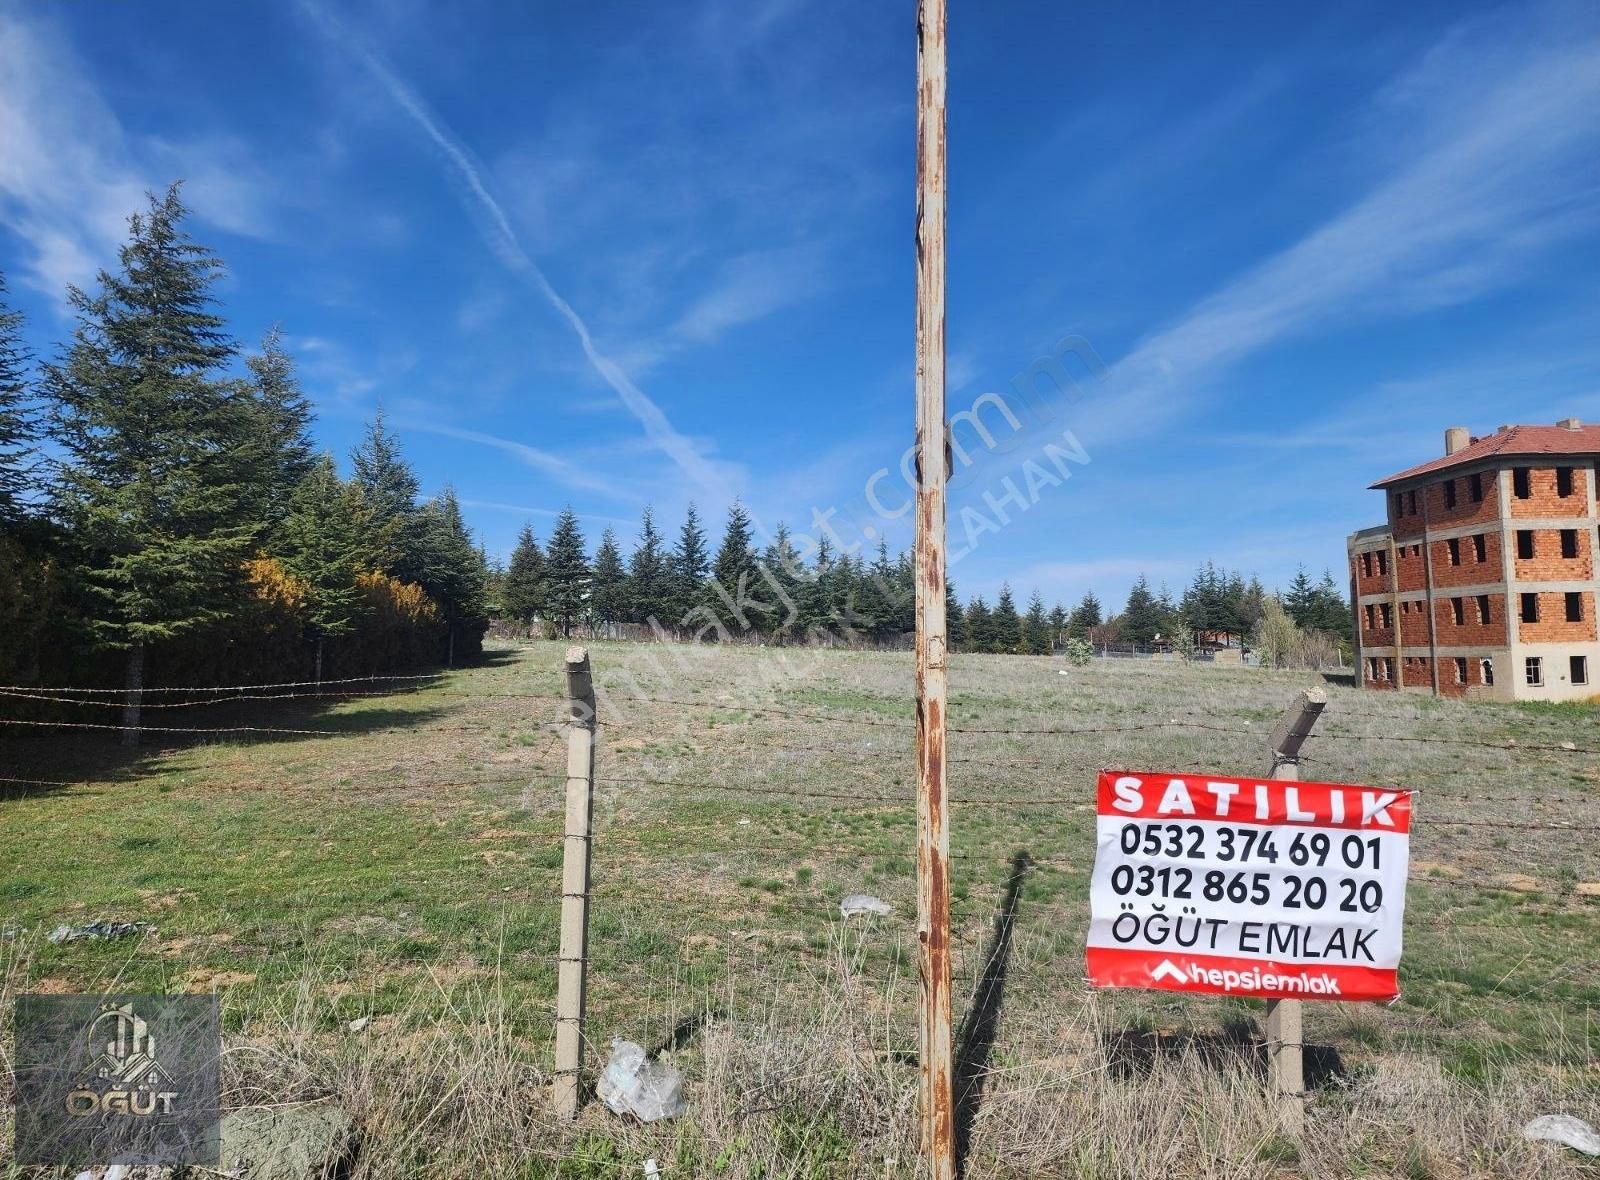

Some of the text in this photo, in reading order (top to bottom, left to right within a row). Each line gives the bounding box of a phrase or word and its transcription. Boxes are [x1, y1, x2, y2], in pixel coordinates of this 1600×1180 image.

[1111, 776, 1398, 827] SATILIK
[1120, 823, 1381, 870] 0532 374 69 01
[1111, 864, 1383, 914] 0312 865 20 20
[1111, 902, 1379, 962] ÖĞÜT EMLAK
[1190, 962, 1342, 995] hepsiemlak
